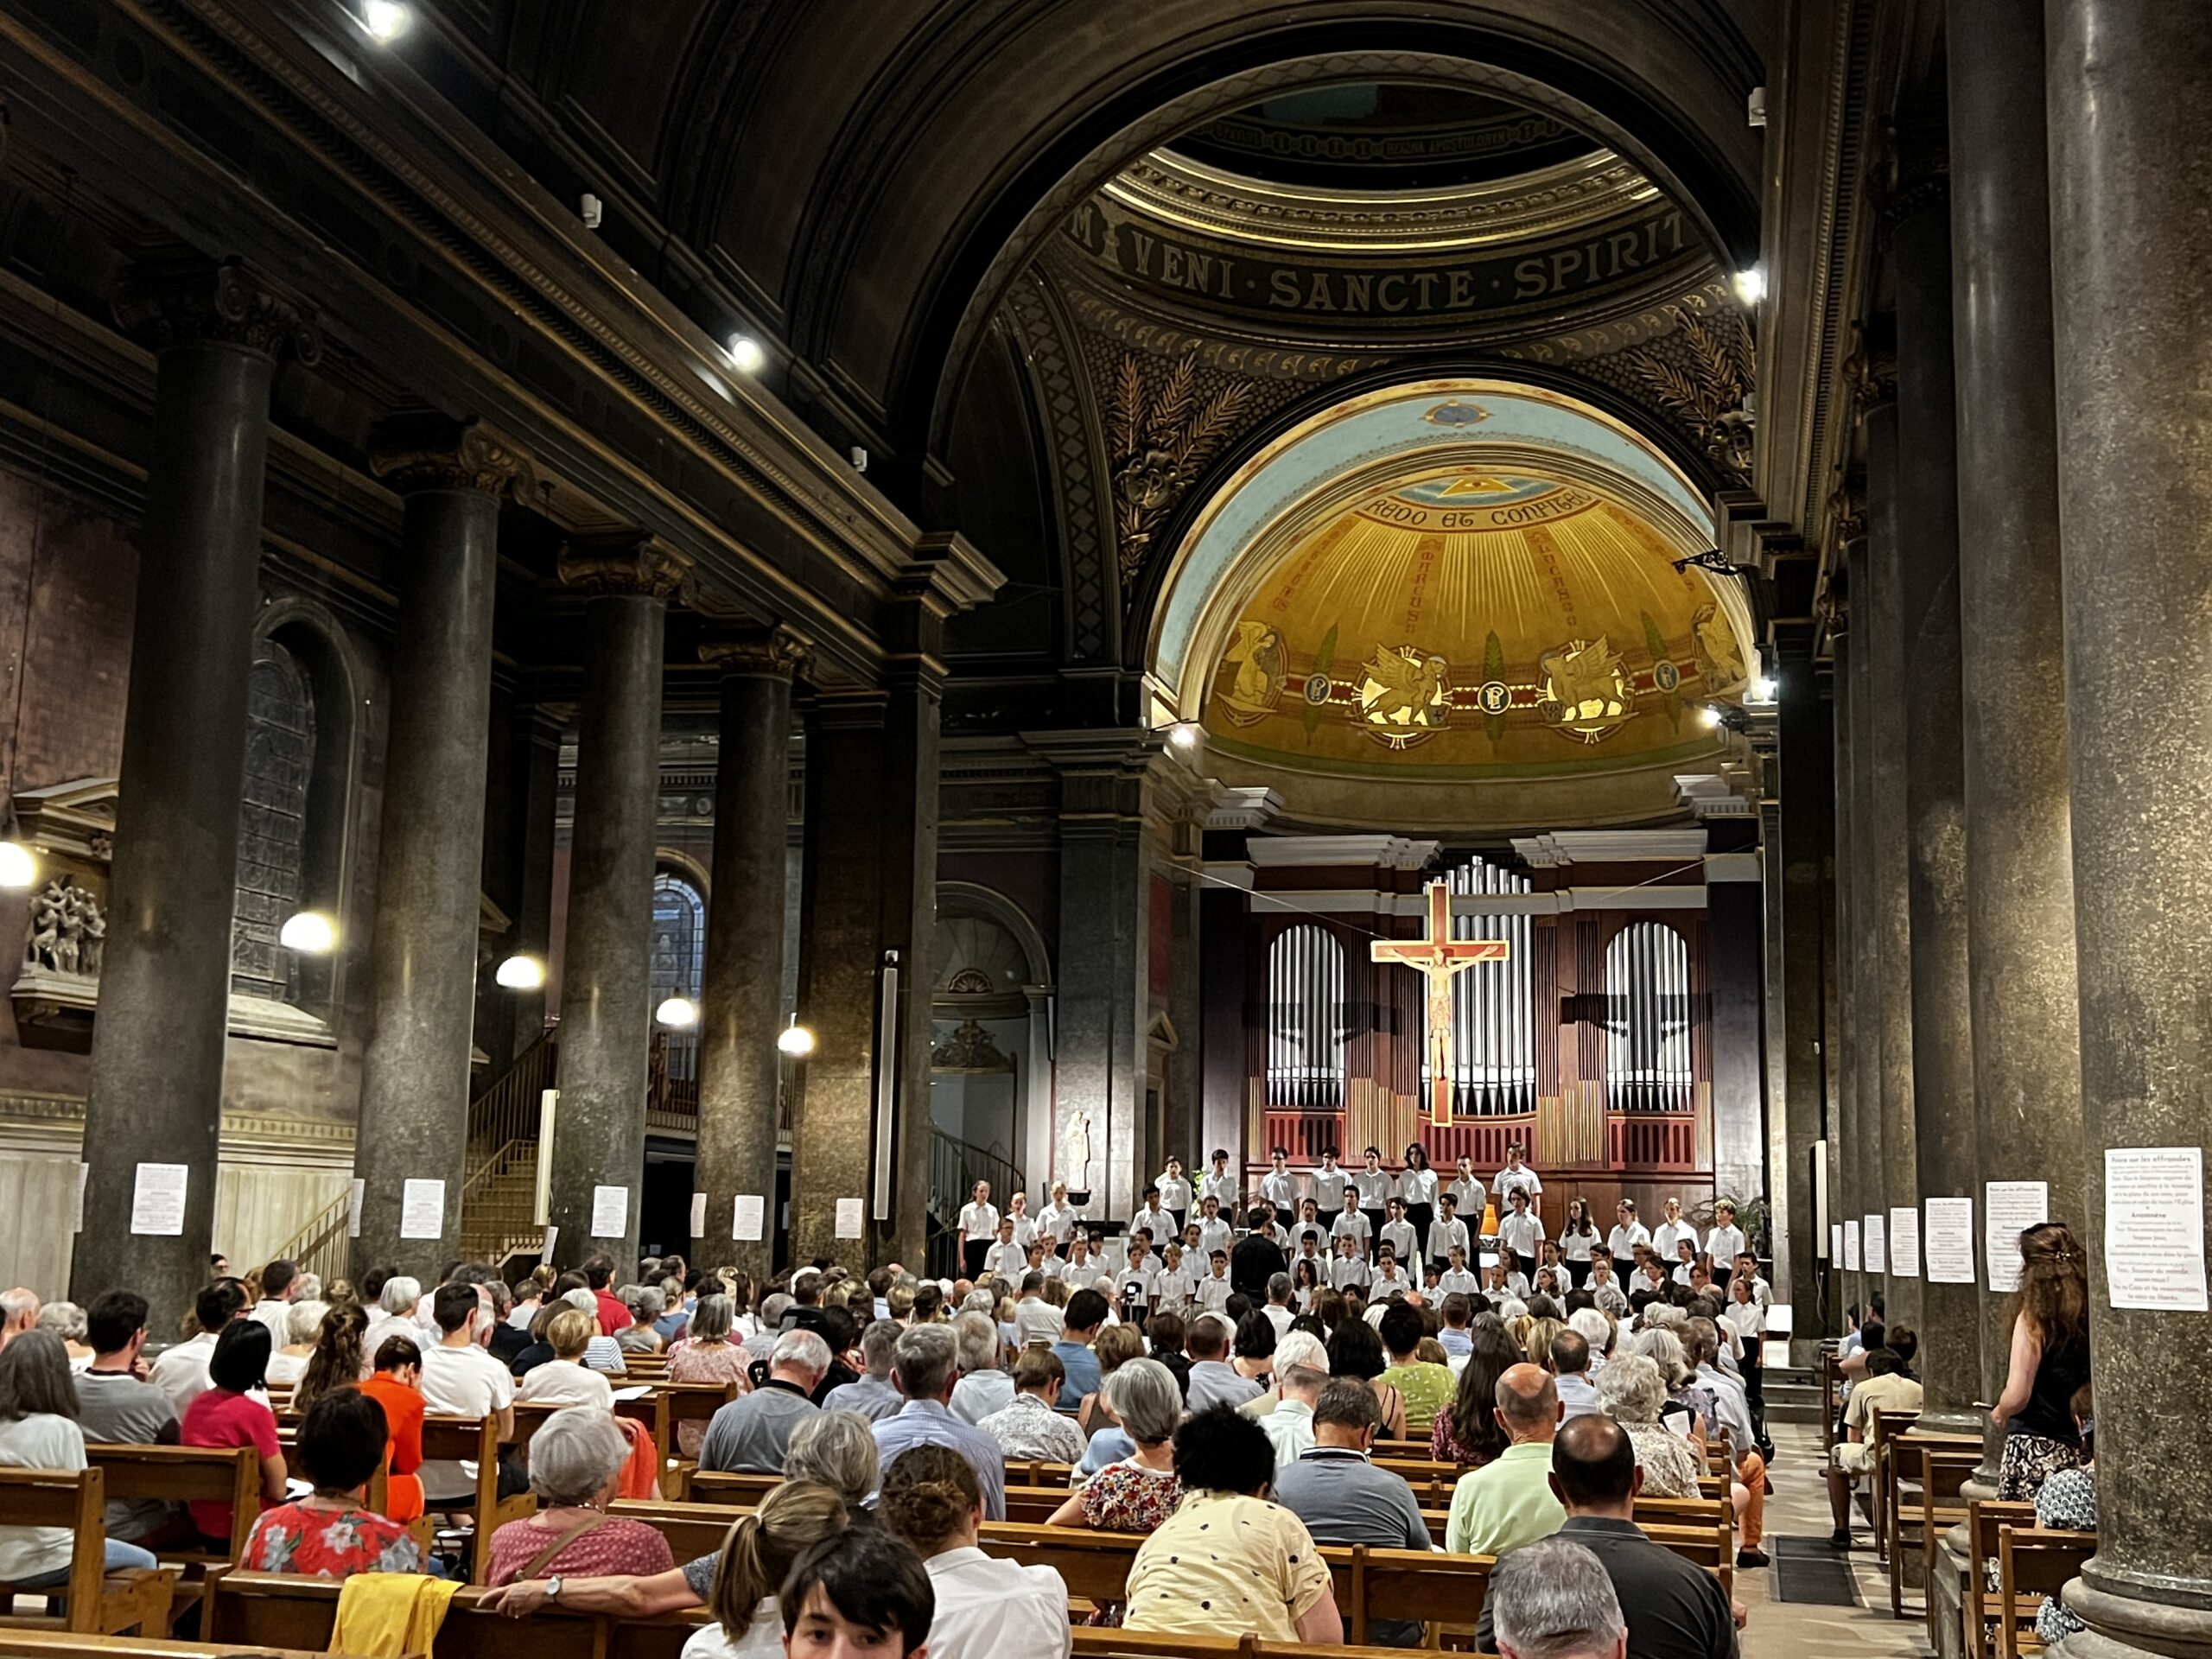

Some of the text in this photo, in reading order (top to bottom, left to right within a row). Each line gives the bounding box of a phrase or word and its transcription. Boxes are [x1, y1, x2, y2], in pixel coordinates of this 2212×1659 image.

[1132, 230, 1236, 299] VENI
[1268, 269, 1477, 313] SANCTE
[1441, 512, 1475, 528] ET
